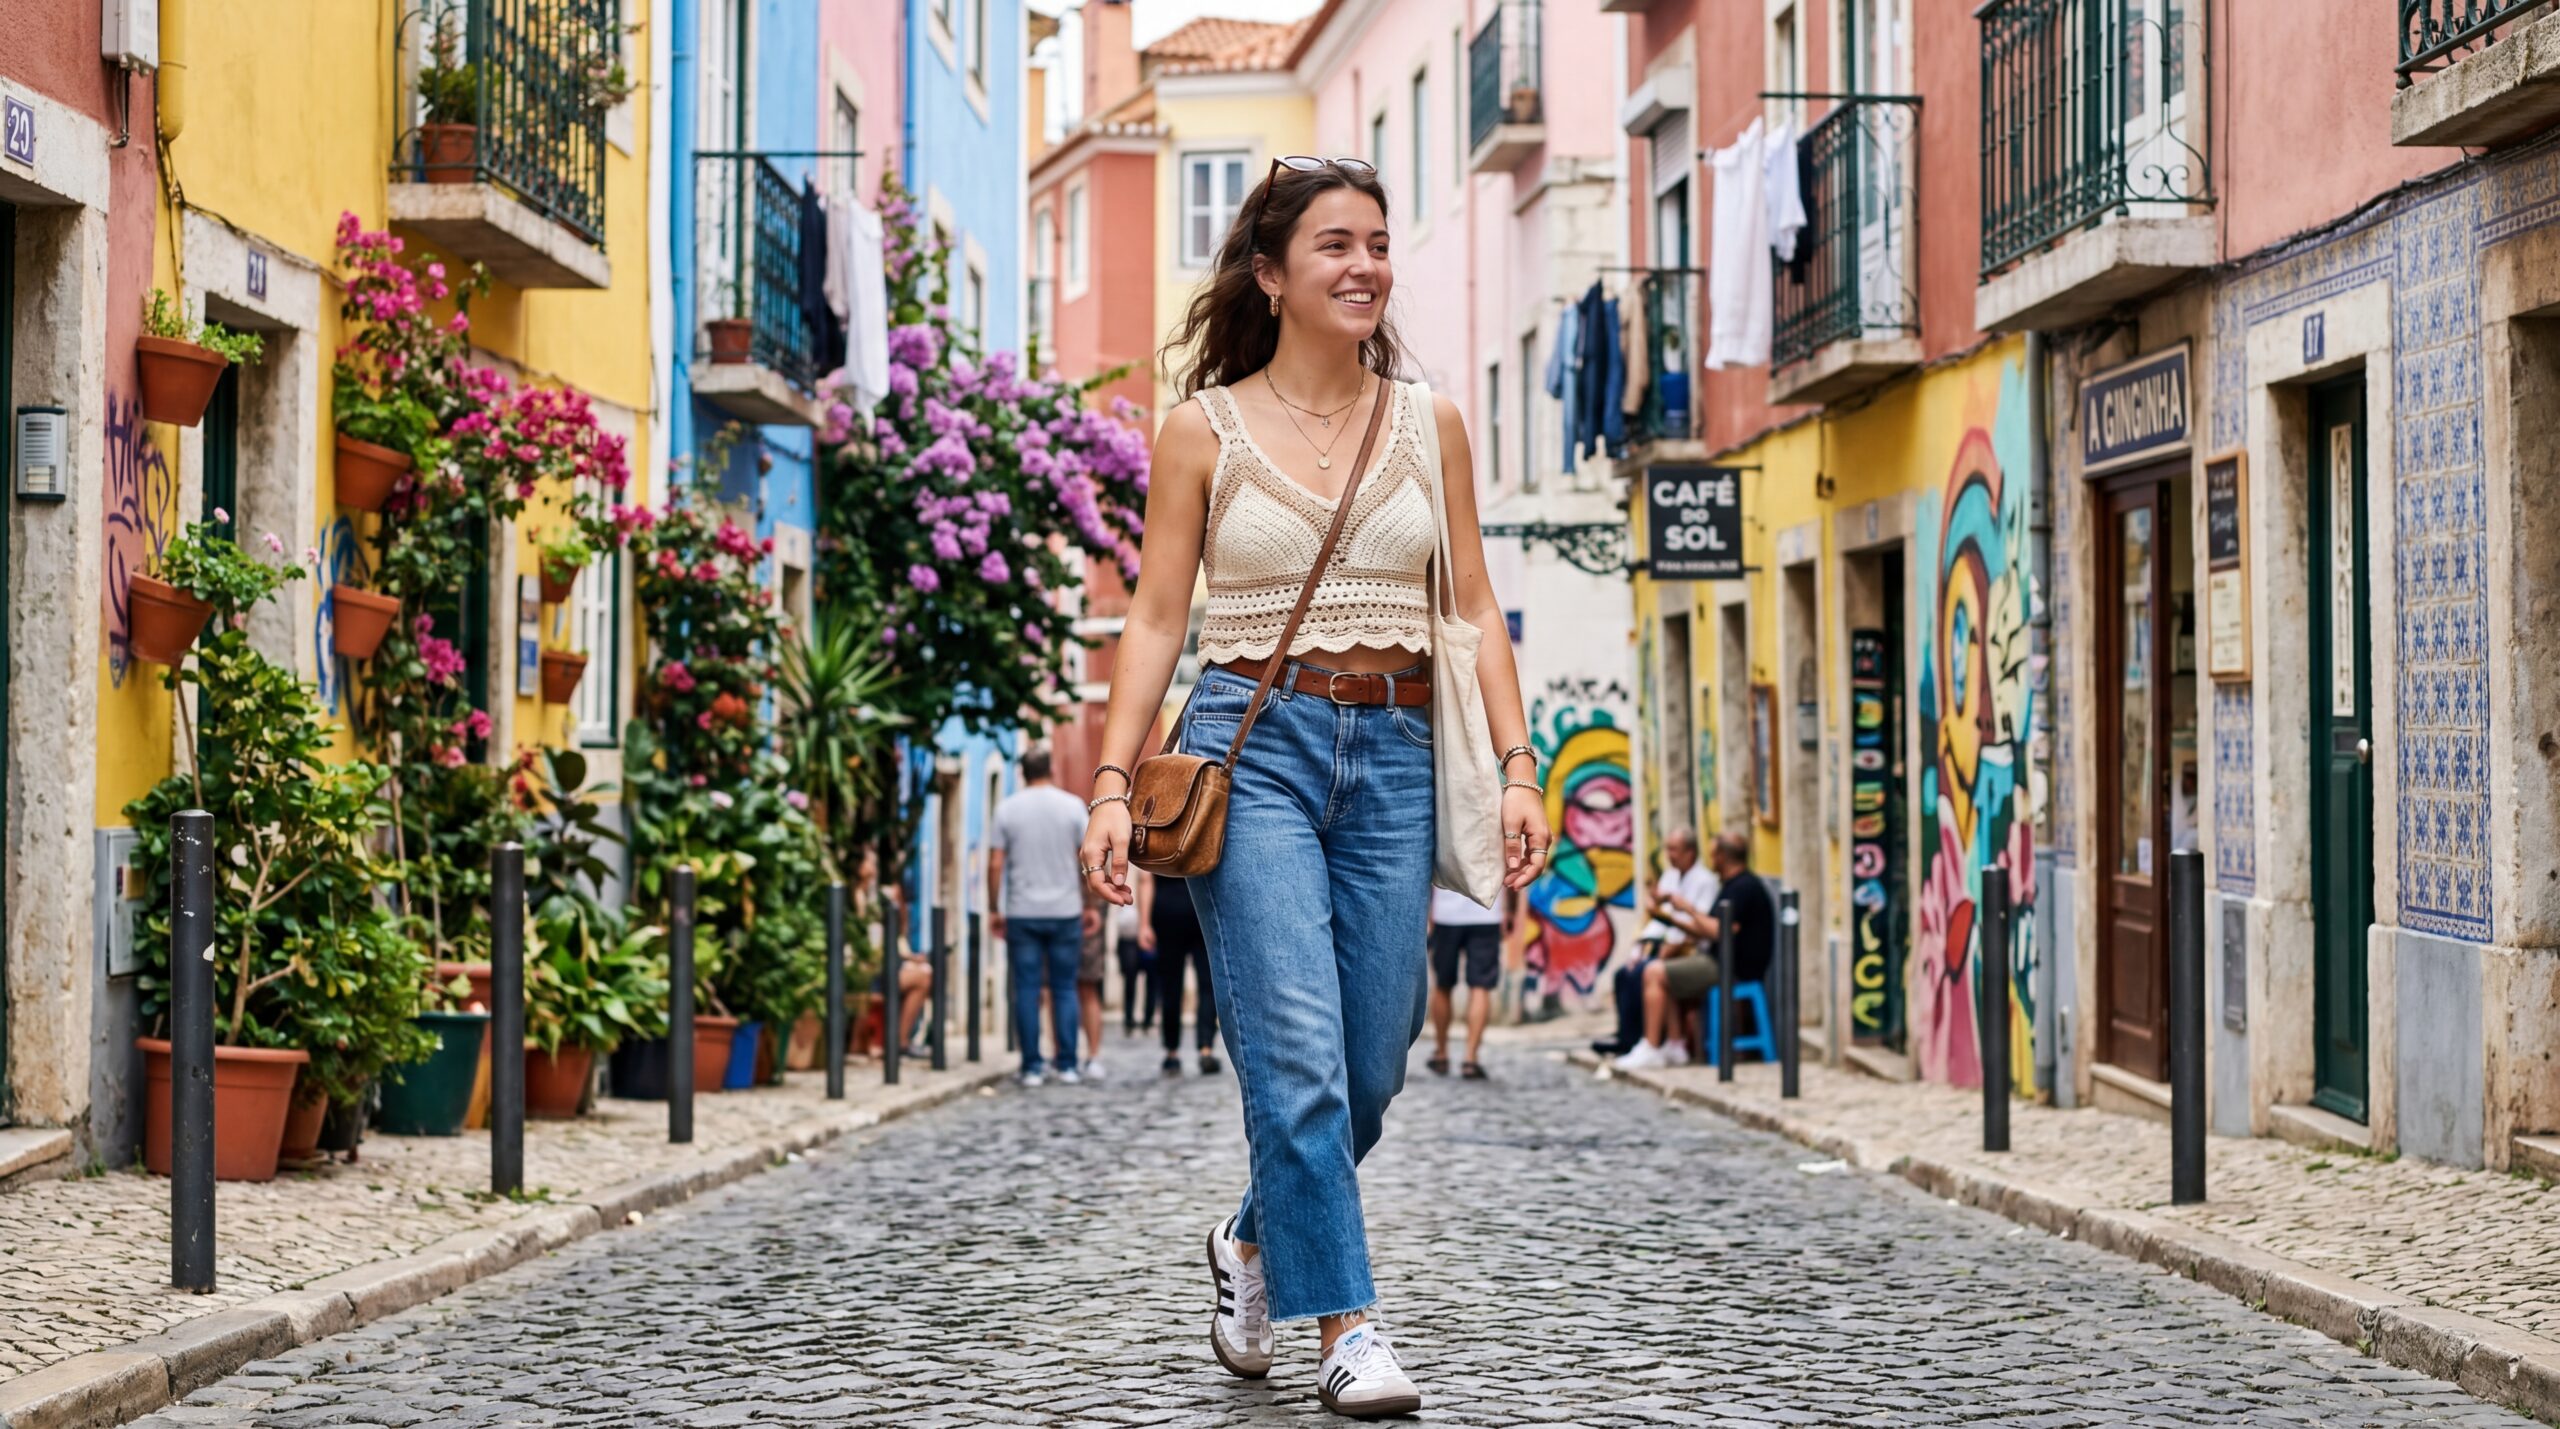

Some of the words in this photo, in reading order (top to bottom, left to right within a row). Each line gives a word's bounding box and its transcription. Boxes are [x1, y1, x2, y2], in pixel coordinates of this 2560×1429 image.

[2088, 396, 2101, 453] A
[2102, 368, 2183, 450] GINGINHA
[1653, 474, 1736, 507] CAFÉ
[1664, 525, 1727, 551] SOL
